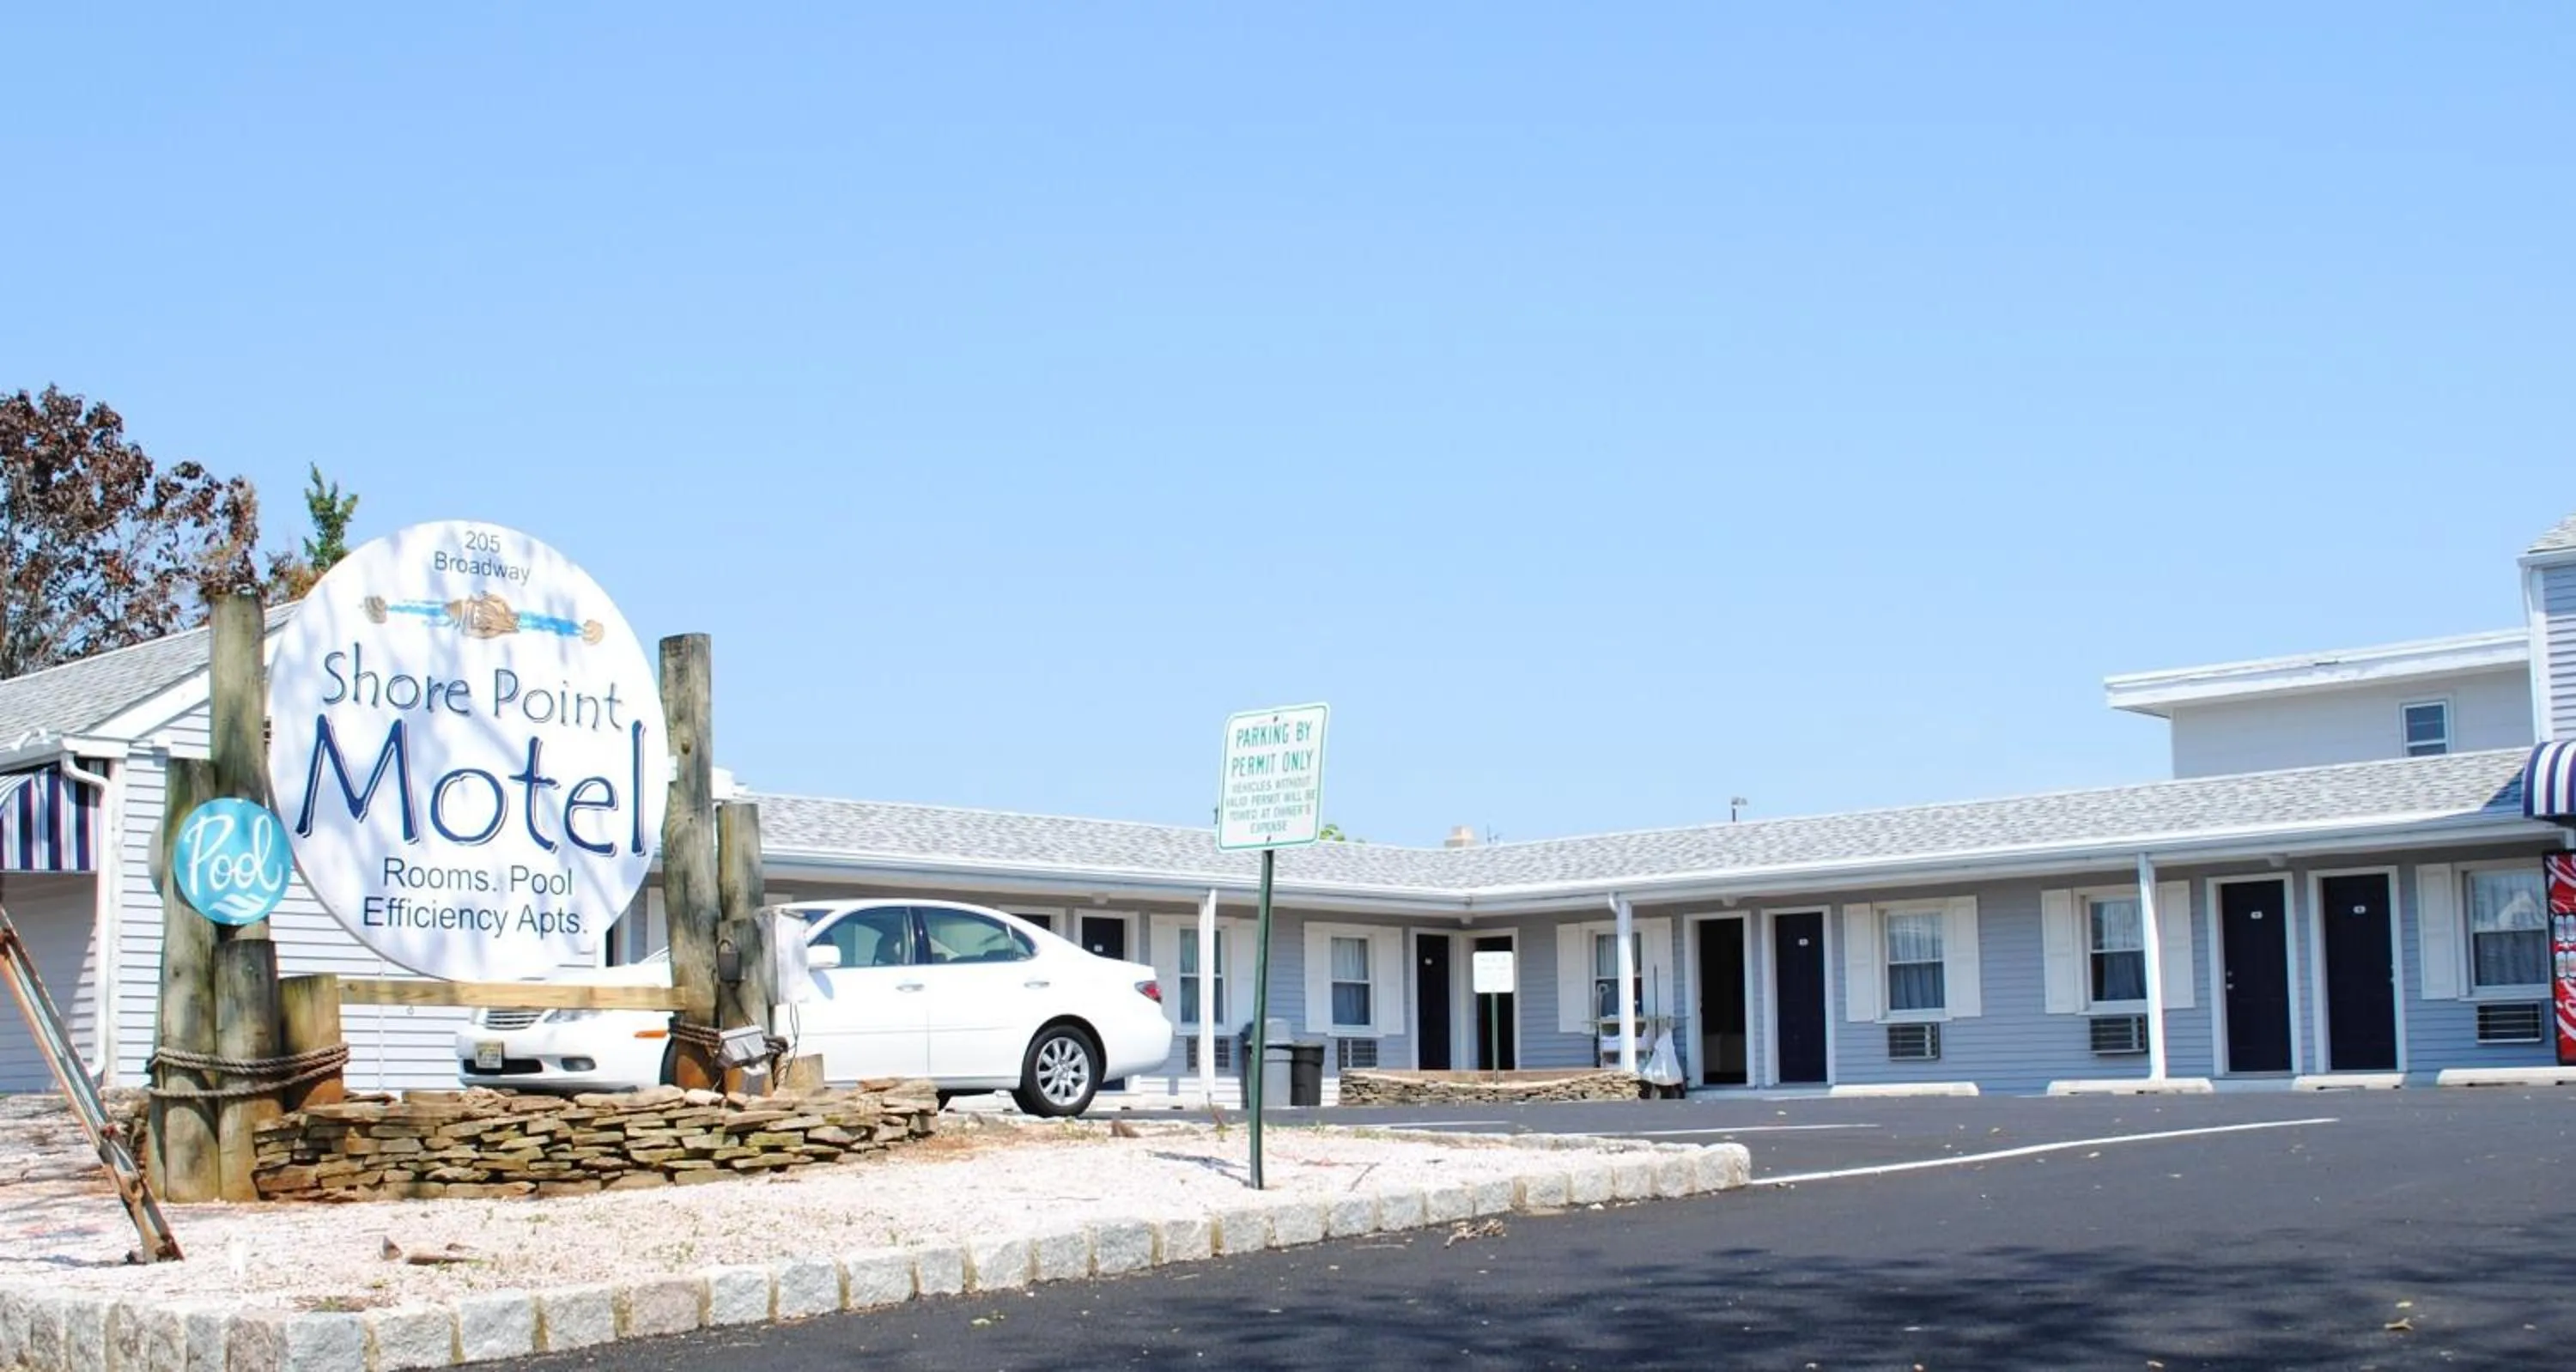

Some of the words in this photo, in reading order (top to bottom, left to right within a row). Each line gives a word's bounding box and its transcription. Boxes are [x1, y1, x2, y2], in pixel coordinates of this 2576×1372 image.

[465, 530, 501, 554] 205
[434, 550, 532, 586] Broadway
[322, 642, 471, 714] Shore
[493, 667, 626, 732] Point
[1236, 724, 1290, 748] PARKING
[1296, 721, 1313, 742] BY
[1231, 753, 1277, 777] PERMIT
[1282, 749, 1314, 773] ONLY
[296, 713, 647, 857] Motel
[185, 813, 283, 892] Pool
[383, 857, 498, 892] Rooms.
[509, 865, 574, 895] Pool
[362, 896, 508, 937] Efficiency
[516, 905, 588, 938] Apts.
